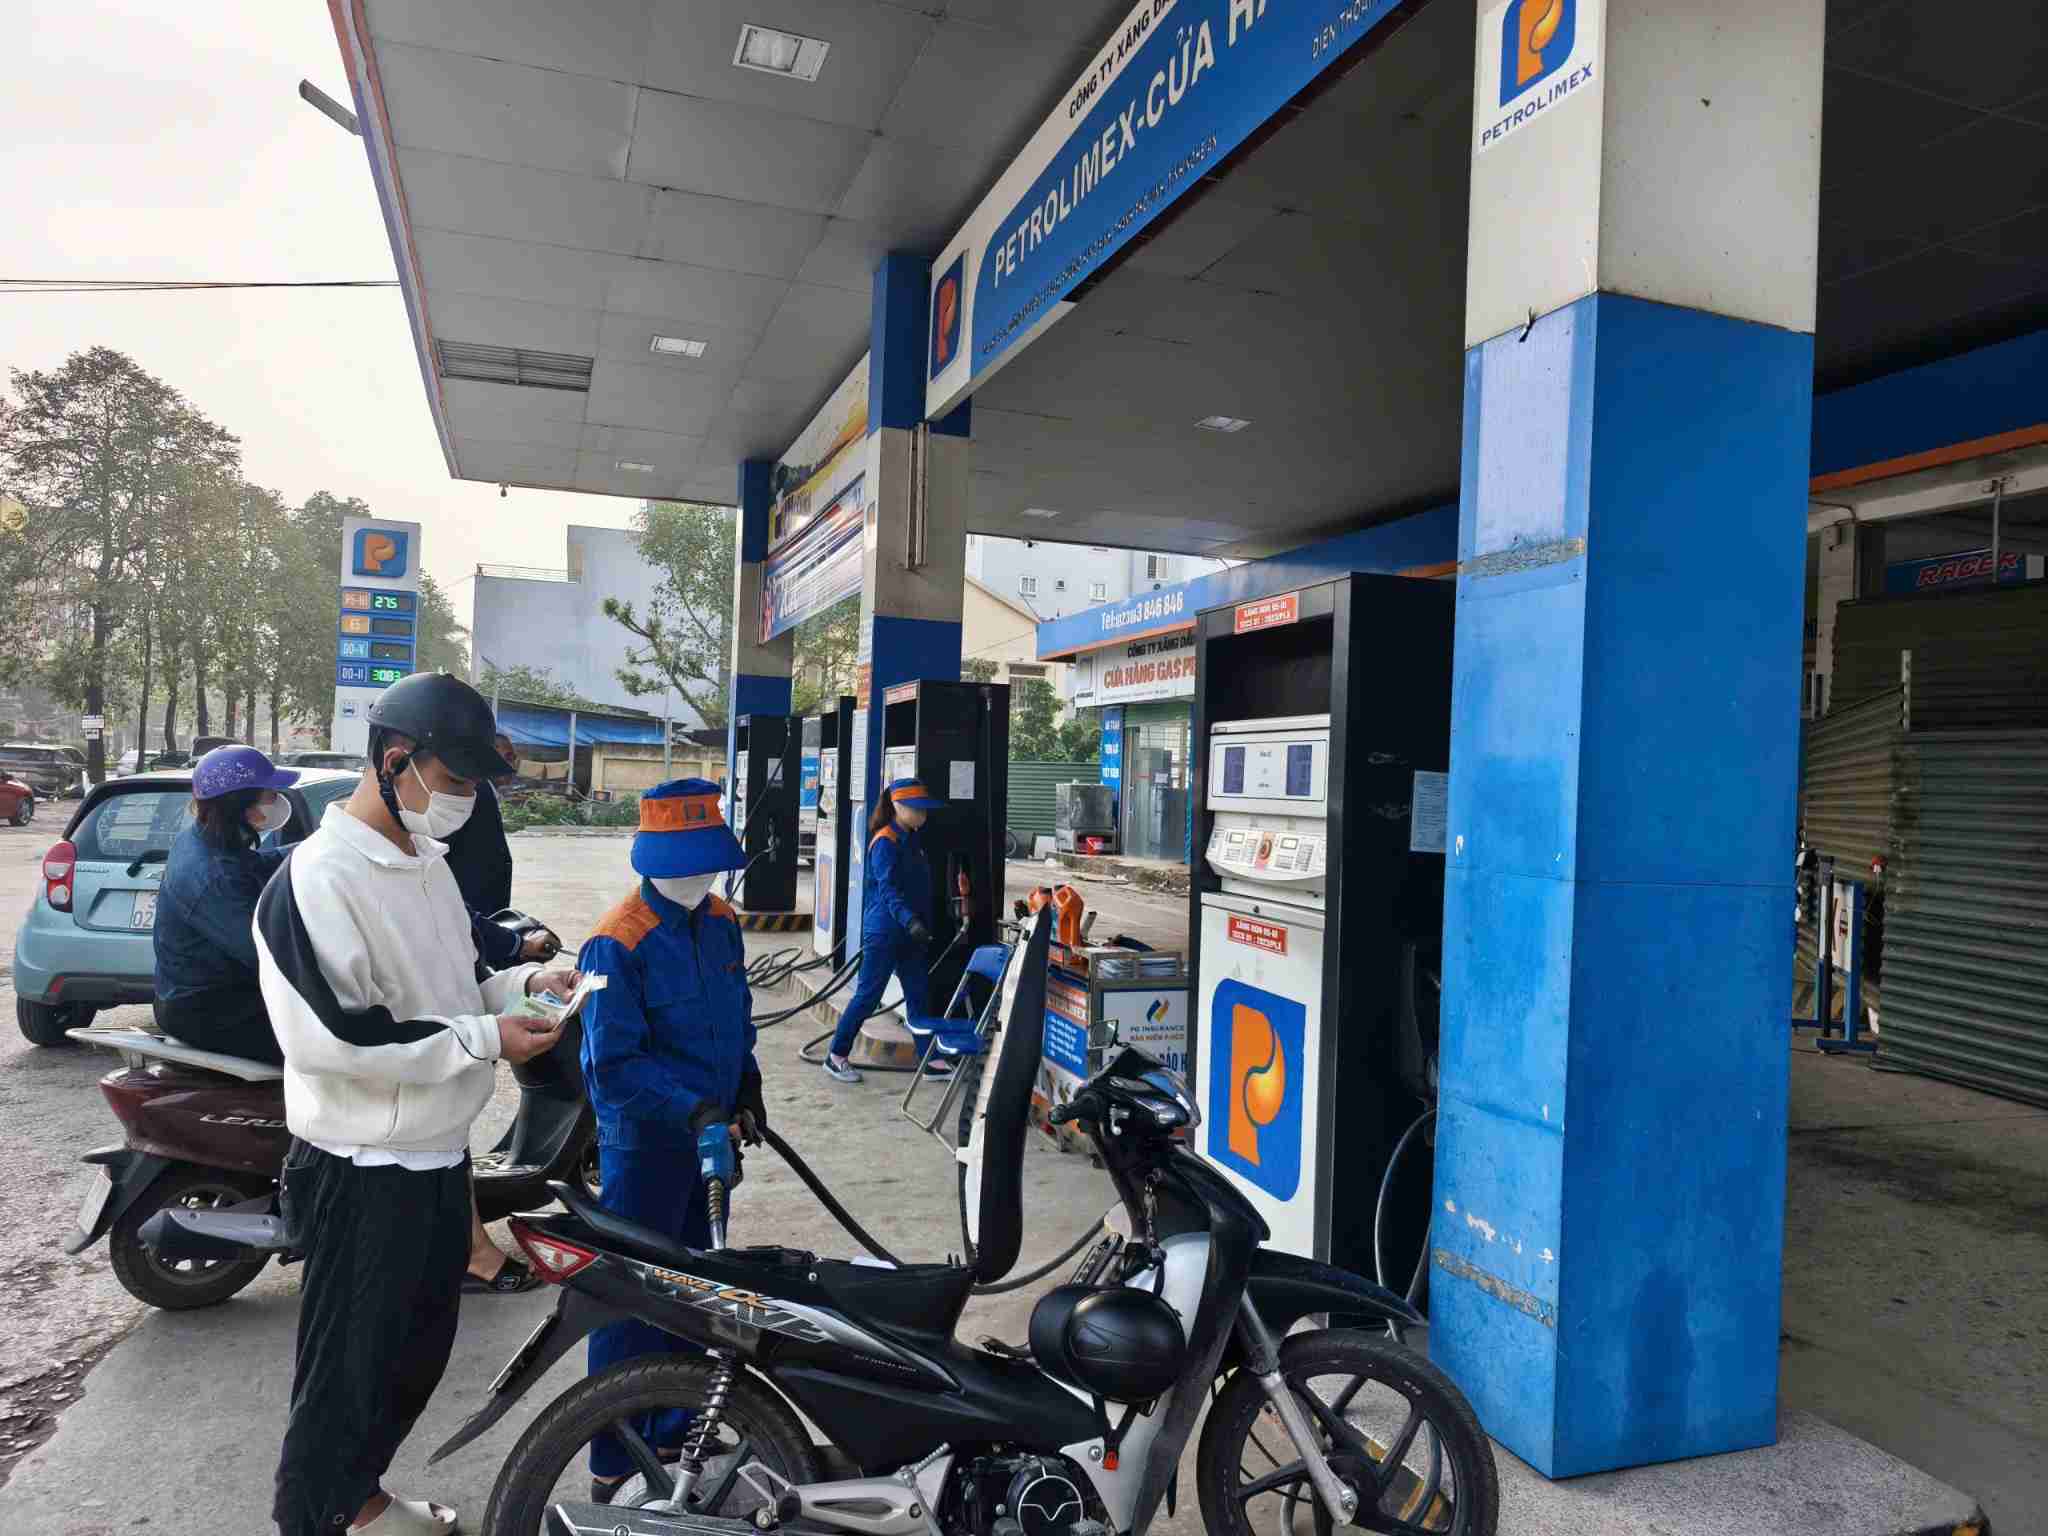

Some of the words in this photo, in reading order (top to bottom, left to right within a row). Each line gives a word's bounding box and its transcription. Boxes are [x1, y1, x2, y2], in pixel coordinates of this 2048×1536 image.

[1069, 74, 1097, 119] CÔNG
[1099, 52, 1114, 80] TY
[1481, 61, 1593, 146] PETROLIMEX
[1157, 656, 1181, 681] GAS
[133, 911, 154, 928] 02
[654, 1268, 715, 1291] WAVE
